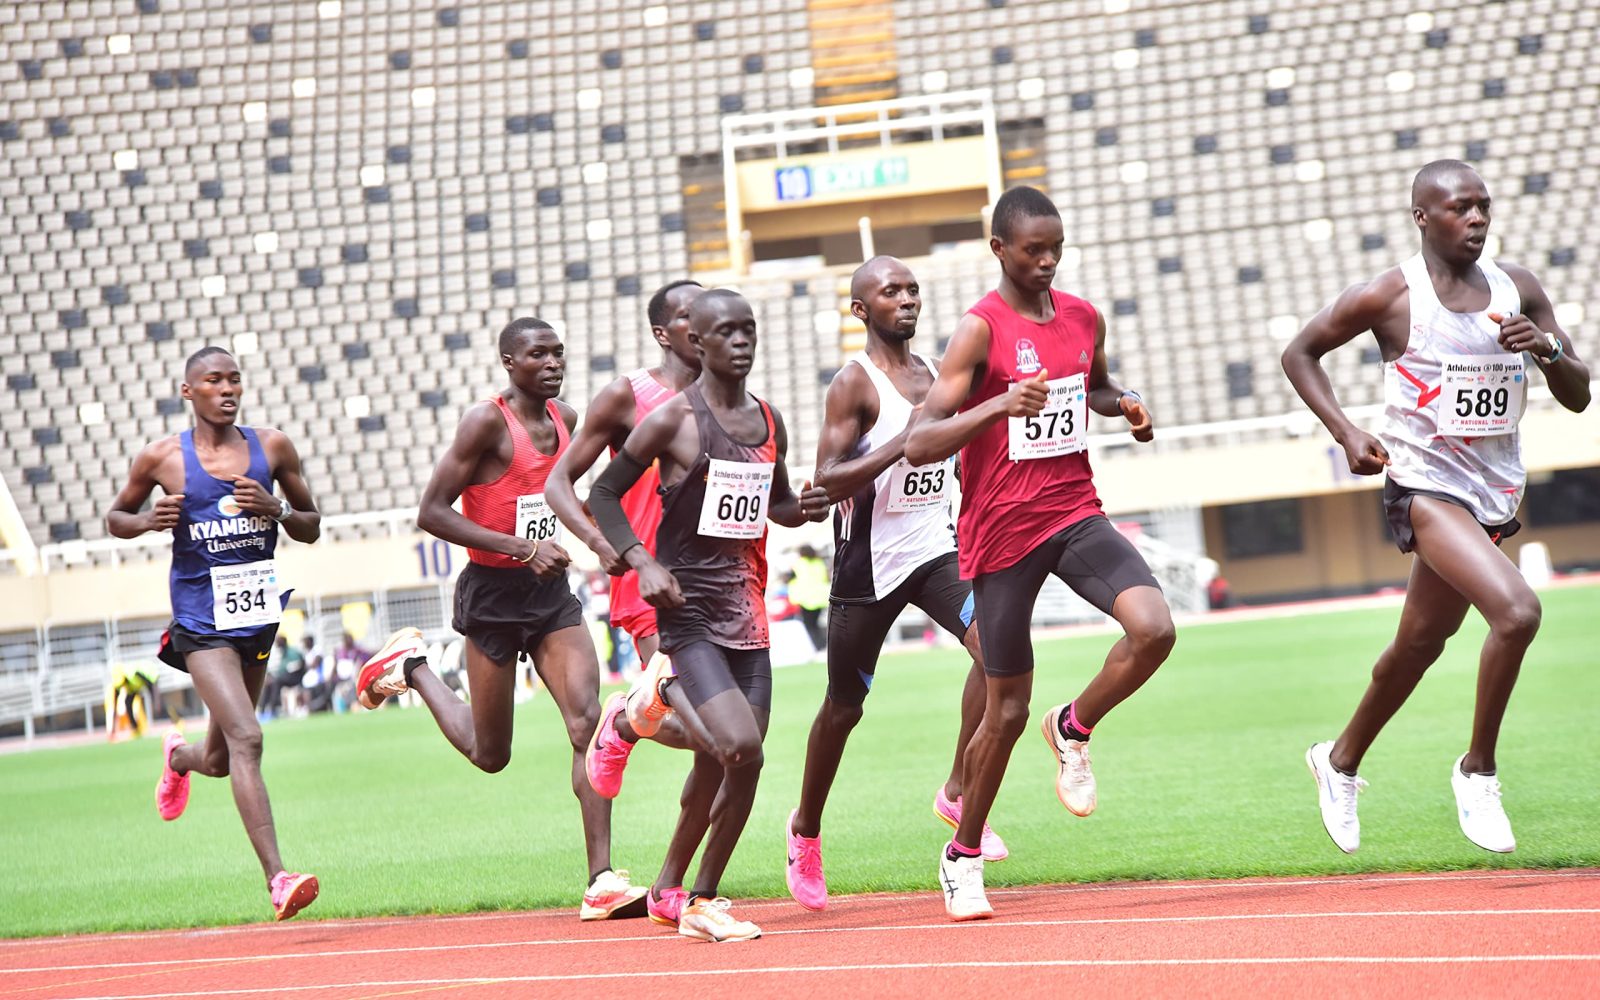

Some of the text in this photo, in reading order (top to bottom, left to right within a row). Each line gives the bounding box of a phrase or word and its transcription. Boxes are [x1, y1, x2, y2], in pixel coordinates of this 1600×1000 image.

[1446, 363, 1481, 372] Athletics
[1492, 363, 1504, 372] 100
[1504, 363, 1522, 373] years
[1056, 386, 1068, 396] 100
[1068, 384, 1083, 394] years
[1455, 387, 1509, 417] 589
[1025, 409, 1074, 441] 573
[1460, 418, 1489, 426] NATIONAL
[713, 470, 743, 480] Athletics
[903, 468, 946, 496] 653
[717, 494, 761, 522] 609
[526, 514, 557, 541] 683
[206, 535, 265, 553] University
[415, 540, 452, 578] 10
[225, 588, 266, 615] 534
